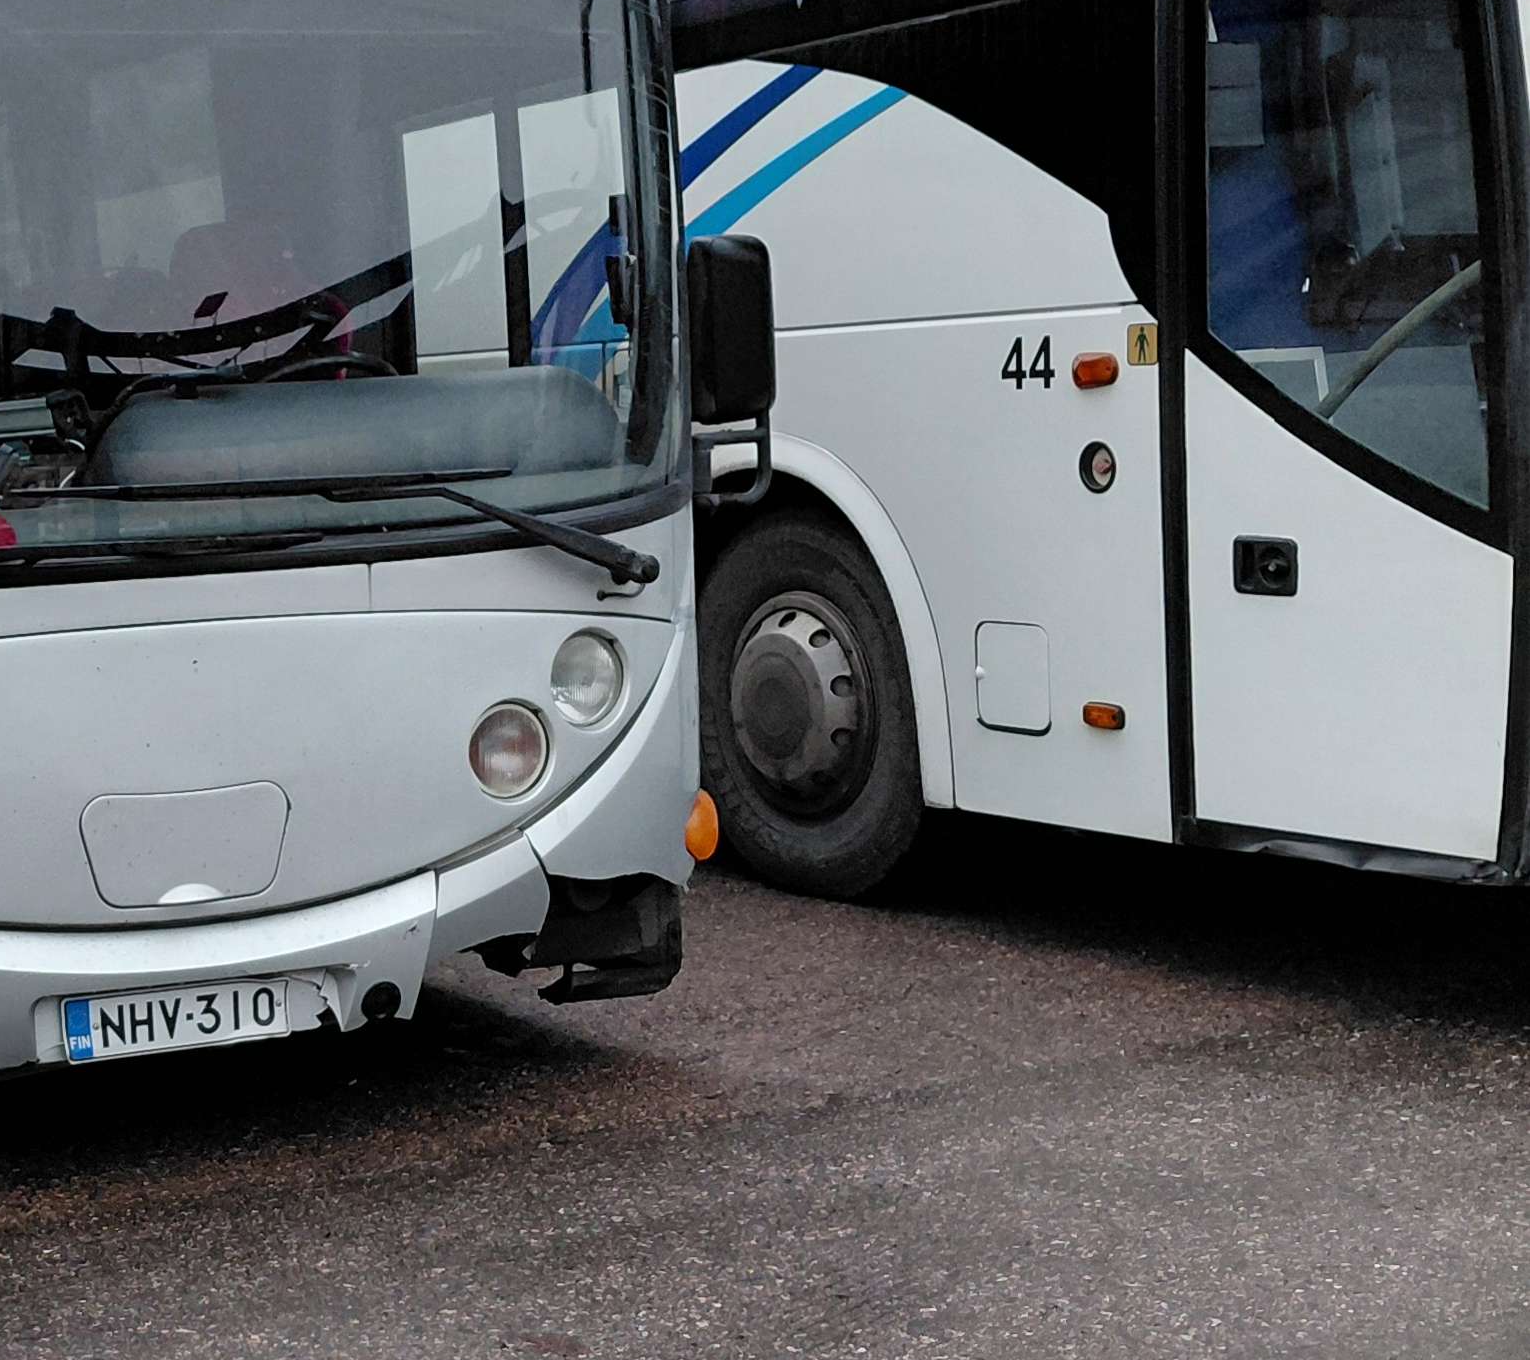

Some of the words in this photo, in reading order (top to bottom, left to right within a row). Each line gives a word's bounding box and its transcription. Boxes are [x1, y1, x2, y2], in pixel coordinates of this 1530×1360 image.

[1001, 334, 1056, 390] 44
[69, 1035, 91, 1050] FIN
[99, 986, 276, 1048] NHV-310
